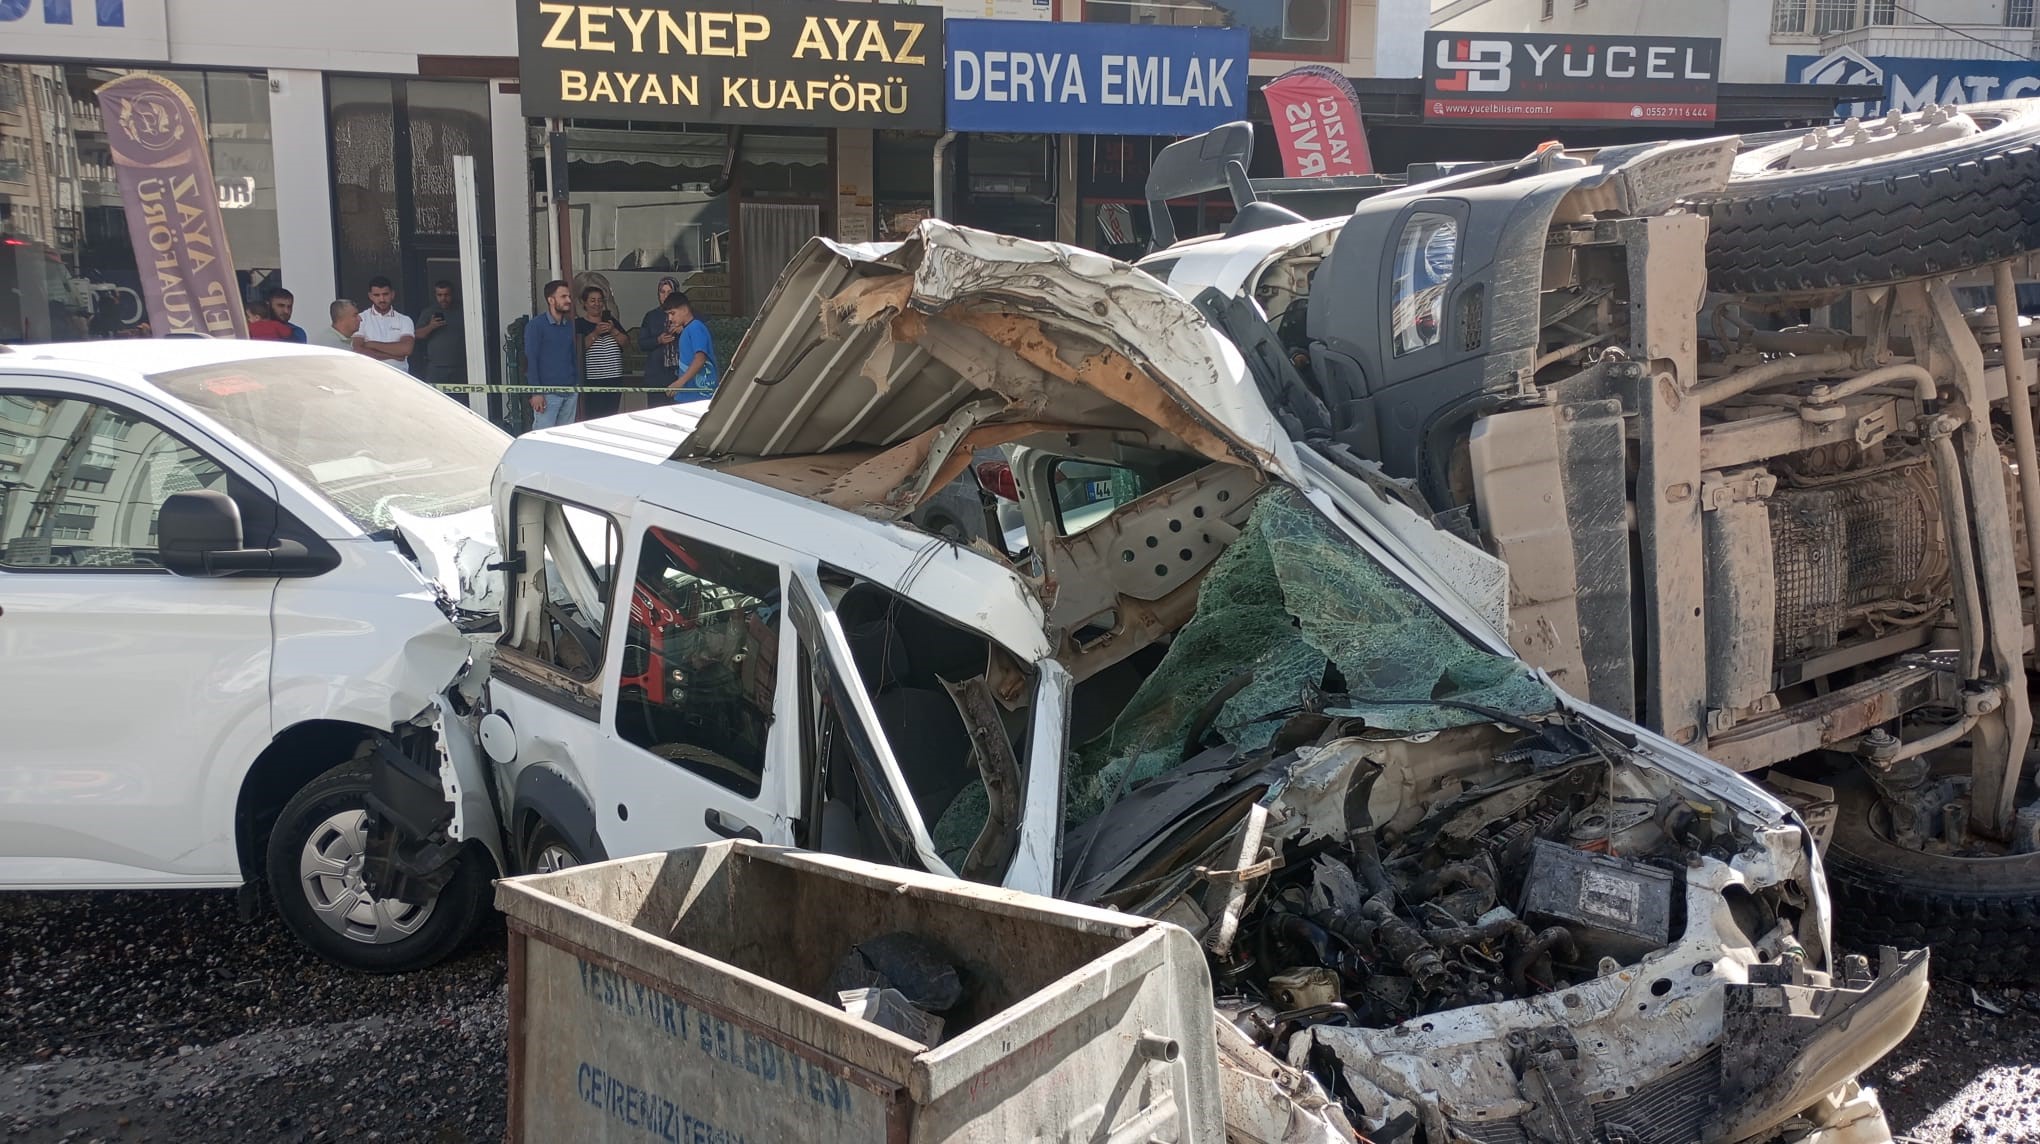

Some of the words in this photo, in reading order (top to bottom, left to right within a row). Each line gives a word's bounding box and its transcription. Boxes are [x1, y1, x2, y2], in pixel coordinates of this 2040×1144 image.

[539, 3, 770, 58] ZEYNEP
[792, 16, 926, 67] AYAZ
[953, 50, 1087, 104] DERYA
[1101, 55, 1233, 107] EMLAK
[1523, 43, 1711, 80] YÜCEL
[560, 69, 699, 106] BAYAN
[722, 74, 908, 114] KUAFÖRÜ
[1646, 107, 1667, 116] 0552
